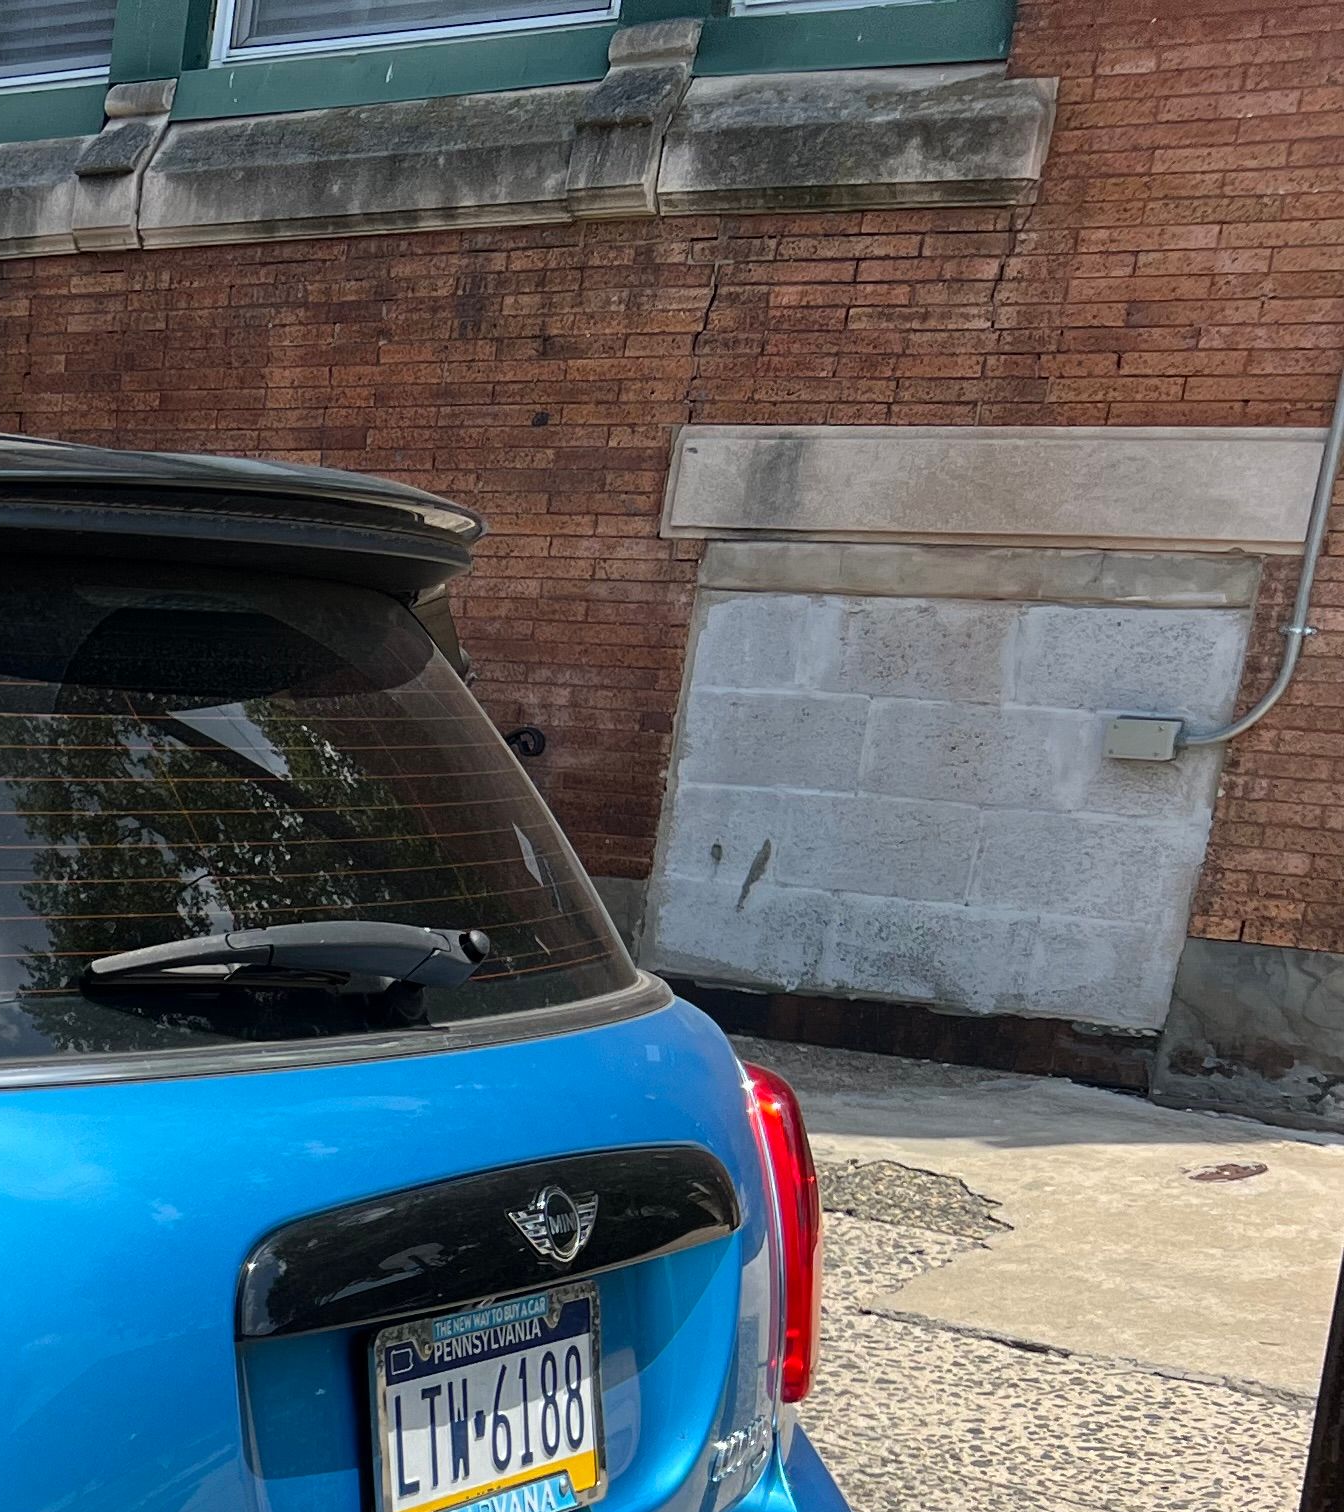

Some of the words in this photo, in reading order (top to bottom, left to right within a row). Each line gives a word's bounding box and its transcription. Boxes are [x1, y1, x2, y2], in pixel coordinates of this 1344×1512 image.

[435, 1319, 452, 1338] THE
[453, 1314, 472, 1332] NEW
[472, 1310, 491, 1328] WAY
[492, 1307, 503, 1325] TO
[503, 1302, 521, 1321] BUY
[520, 1302, 529, 1318] A
[527, 1296, 546, 1315] CAR
[433, 1318, 542, 1365] PENNSYLVANIA
